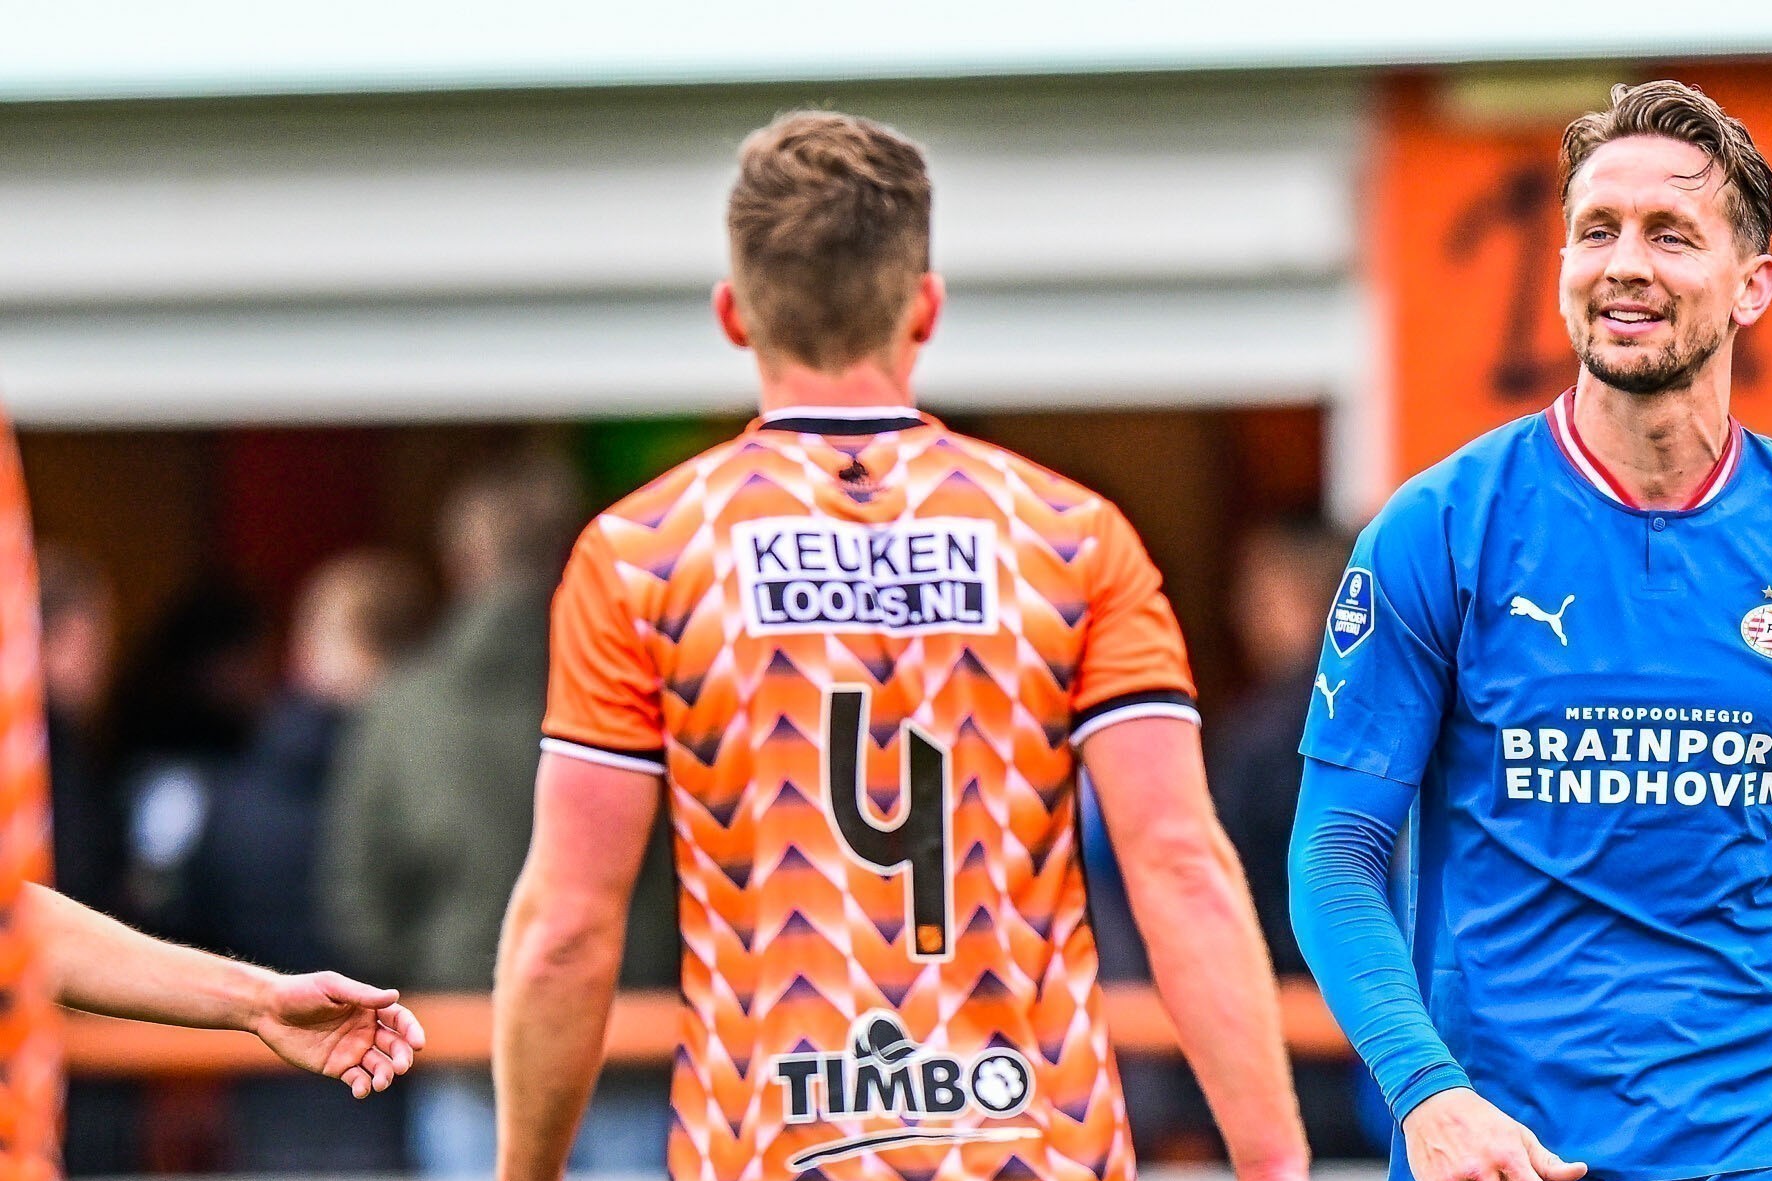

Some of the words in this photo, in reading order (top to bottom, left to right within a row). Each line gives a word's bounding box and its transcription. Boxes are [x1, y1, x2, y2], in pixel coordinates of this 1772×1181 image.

[753, 532, 977, 576] KEUKEN
[757, 580, 983, 628] LOODS.NL
[1565, 707, 1753, 724] METROPOOLREGIO
[826, 686, 950, 960] 4
[777, 1054, 1029, 1117] TIMBO
